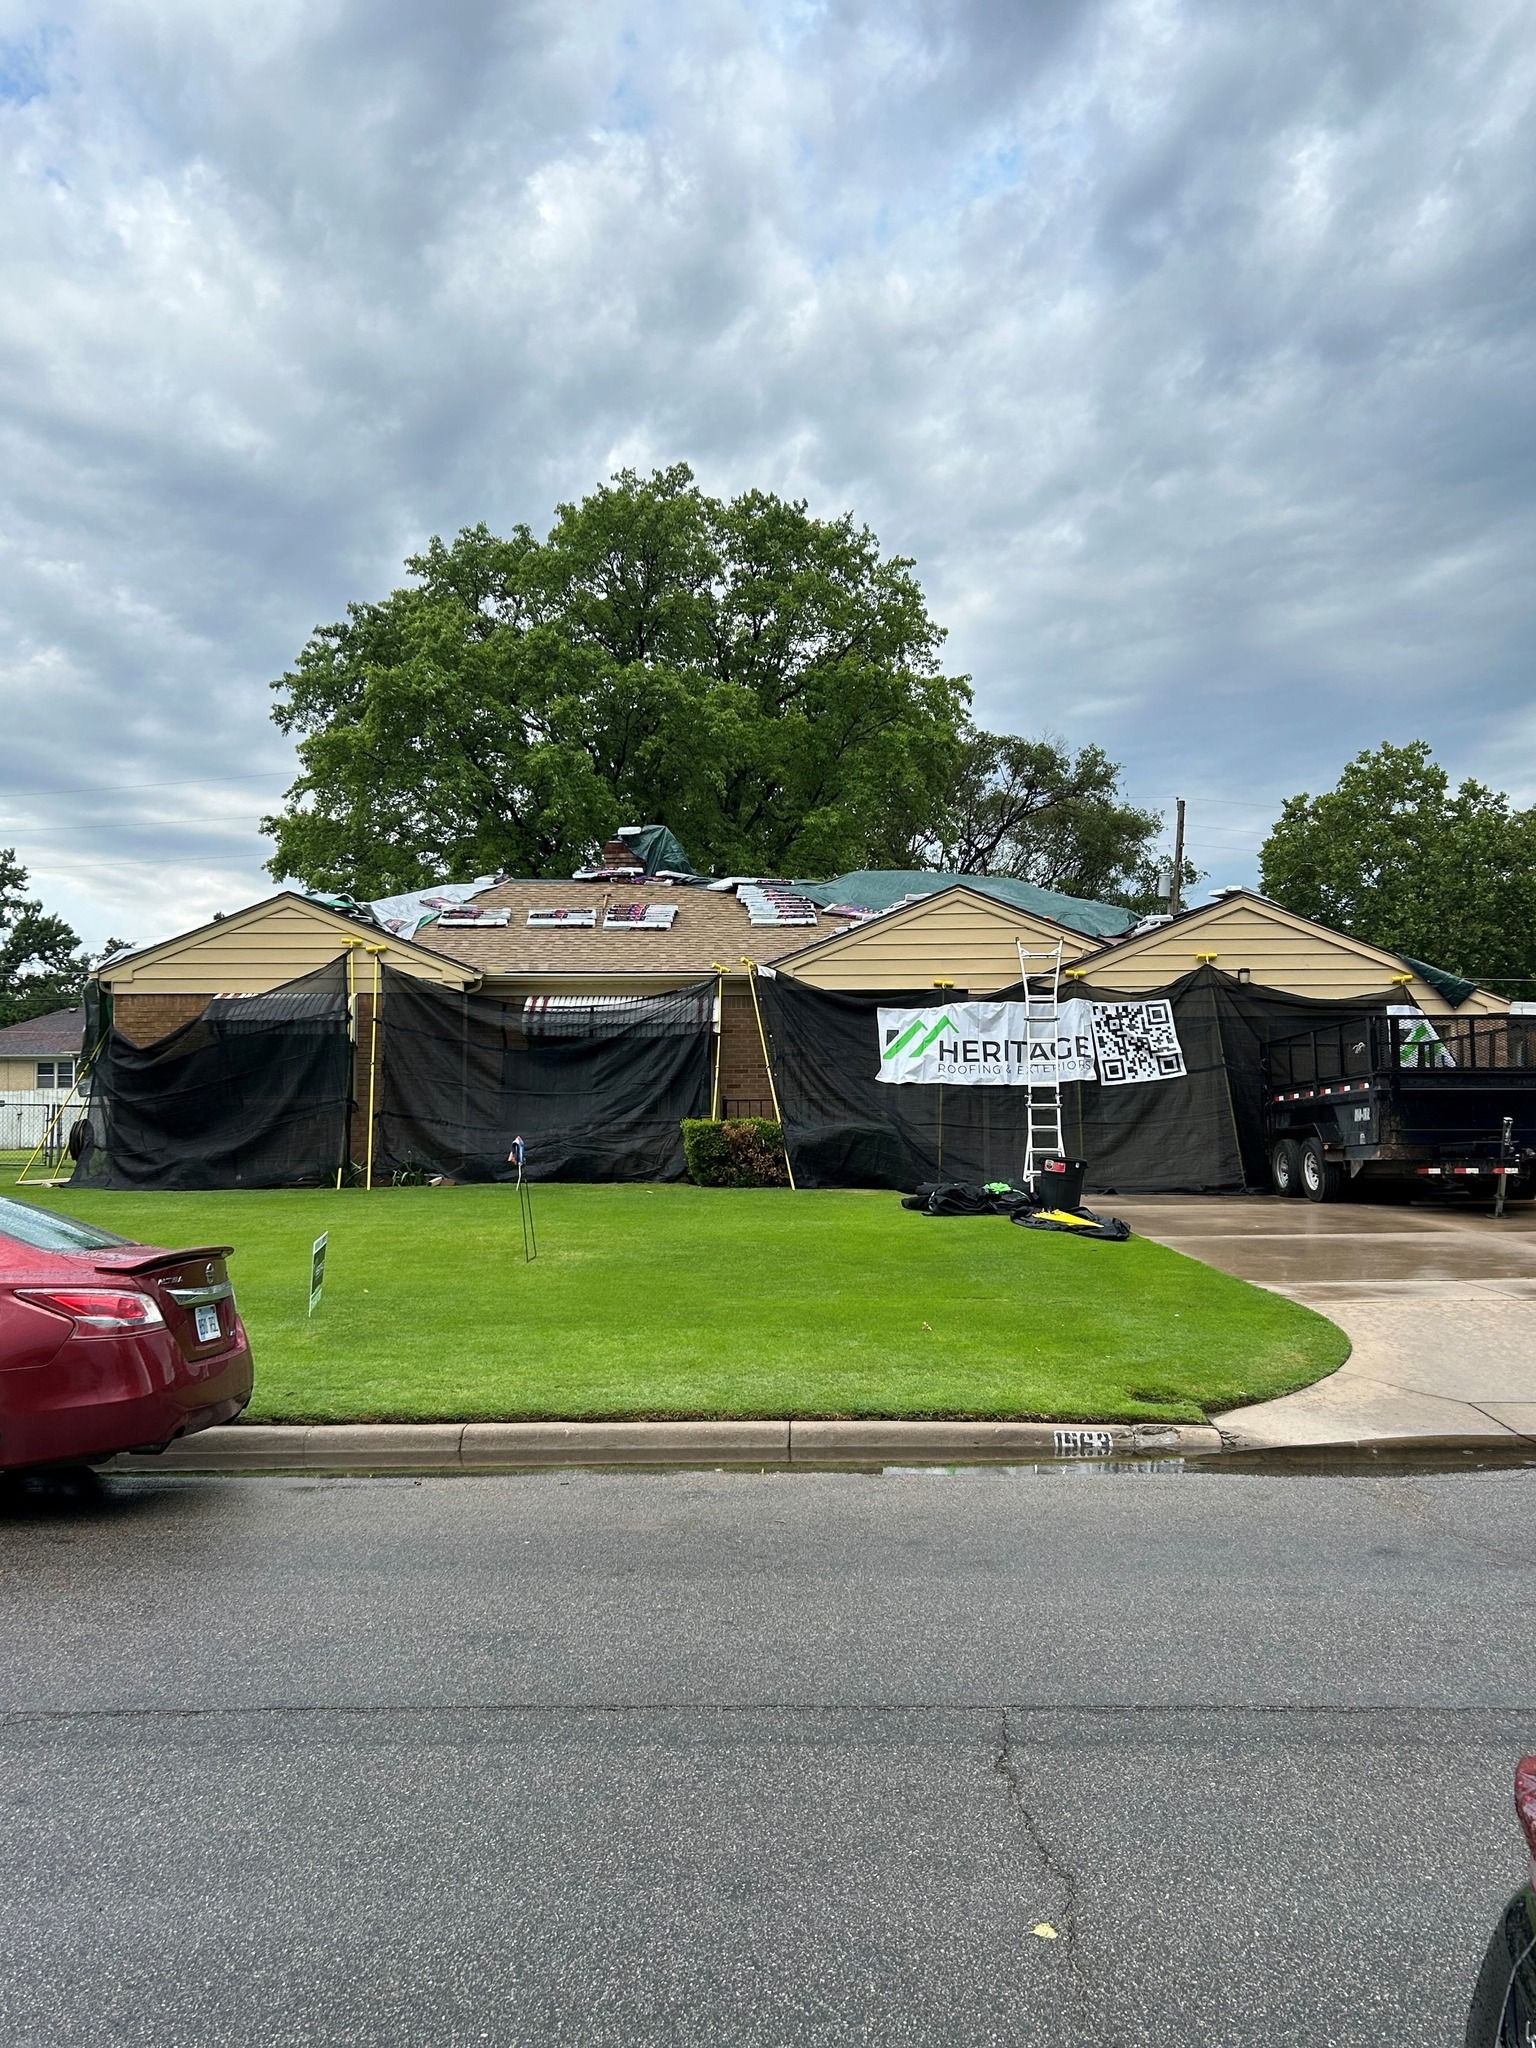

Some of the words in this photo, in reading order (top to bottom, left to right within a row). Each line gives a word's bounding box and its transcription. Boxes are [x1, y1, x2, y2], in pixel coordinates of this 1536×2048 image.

[939, 1036, 1092, 1063] HERITAGE
[938, 1064, 1001, 1074] ROOFING
[1006, 1064, 1012, 1074] &
